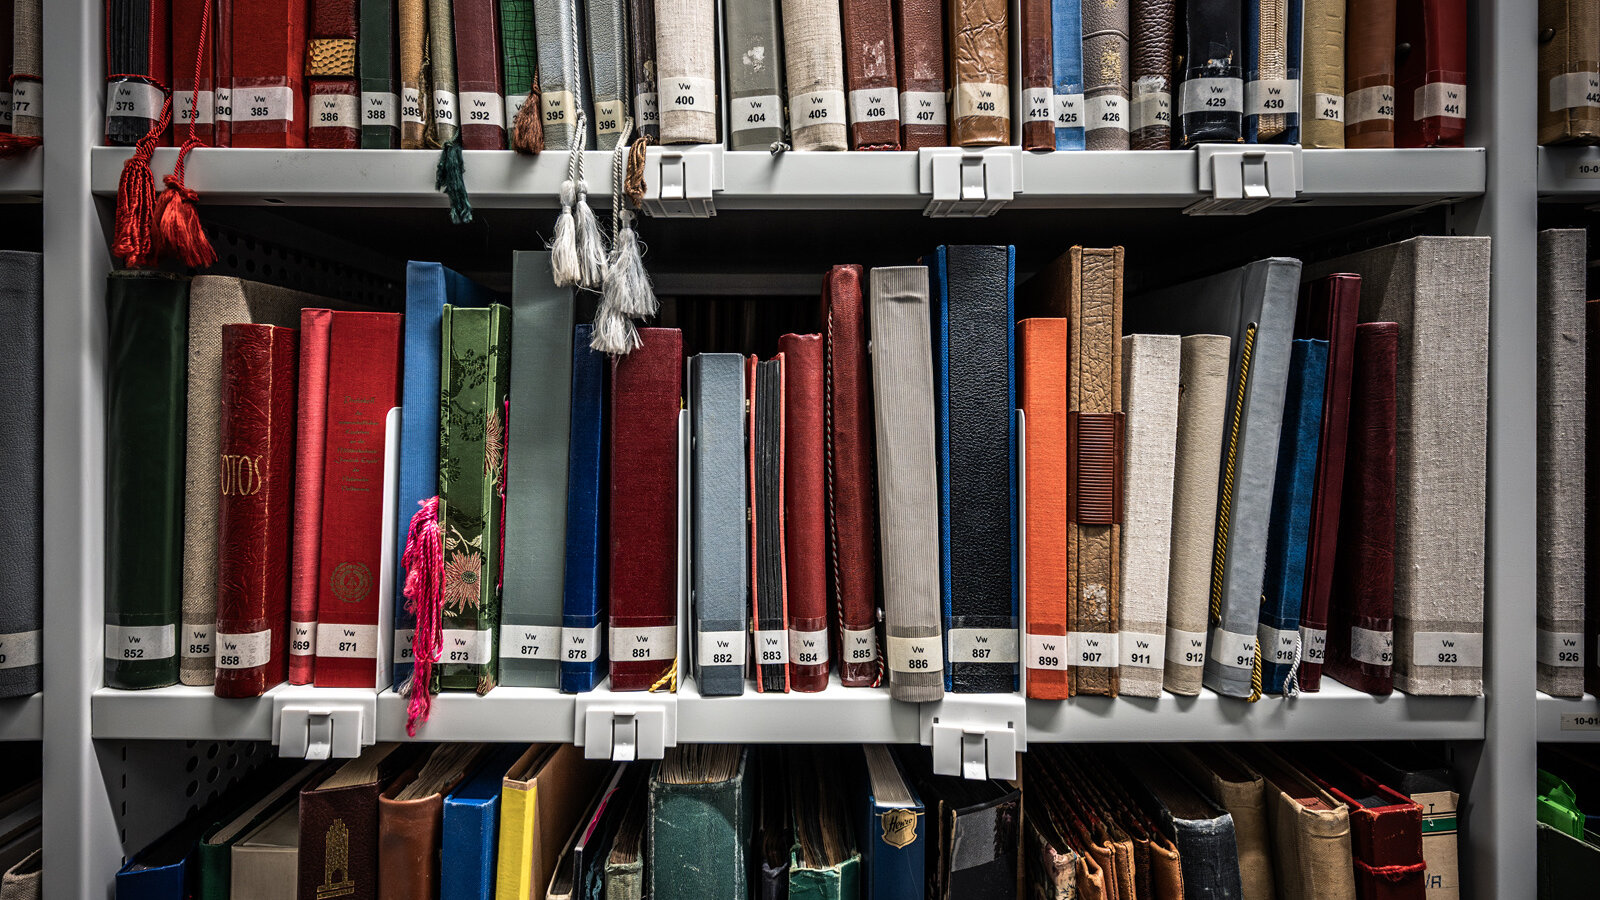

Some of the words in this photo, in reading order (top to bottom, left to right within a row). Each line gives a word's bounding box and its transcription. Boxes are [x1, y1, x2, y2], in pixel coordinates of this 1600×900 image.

[405, 95, 417, 103] Vw
[1448, 91, 1457, 99] Vw
[549, 99, 560, 107] Vw
[675, 96, 695, 105] 400
[1206, 98, 1226, 107] 429
[1264, 99, 1284, 108] 430
[116, 101, 134, 111] 378
[977, 102, 995, 111] 408
[1445, 105, 1459, 114] 441
[251, 107, 268, 116] 385
[367, 109, 386, 119] 388
[470, 111, 489, 121] 392
[546, 110, 564, 120] 395
[809, 109, 827, 119] 405
[867, 107, 885, 117] 406
[916, 112, 935, 121] 407
[1030, 108, 1049, 118] 415
[1323, 108, 1339, 118] 431
[320, 113, 338, 122] 386
[748, 113, 766, 123] 404
[1059, 113, 1077, 123] 425
[1102, 112, 1120, 122] 426
[599, 120, 616, 130] 396
[1579, 165, 1600, 173] 10-0
[221, 454, 264, 496] OTOS
[344, 629, 356, 637] Vw
[293, 640, 310, 650] 869
[339, 642, 357, 652] 871
[1043, 643, 1055, 651] Vw
[1086, 639, 1099, 647] Vw
[1244, 643, 1254, 651] Vw
[1443, 640, 1454, 648] Vw
[124, 648, 143, 658] 852
[190, 644, 209, 653] 855
[401, 648, 414, 657] 87
[521, 645, 539, 655] 877
[632, 648, 650, 658] 881
[853, 648, 870, 658] 885
[972, 648, 991, 658] 887
[450, 651, 468, 661] 873
[568, 649, 587, 659] 878
[713, 653, 732, 663] 882
[763, 651, 781, 660] 883
[799, 652, 817, 662] 884
[1082, 652, 1102, 663] 907
[1132, 653, 1150, 664] 911
[1186, 652, 1203, 662] 912
[1276, 650, 1293, 660] 918
[1382, 653, 1392, 661] 92
[1438, 653, 1457, 662] 923
[1559, 652, 1579, 661] 926
[221, 655, 239, 665] 858
[909, 659, 928, 669] 886
[1038, 656, 1058, 666] 899
